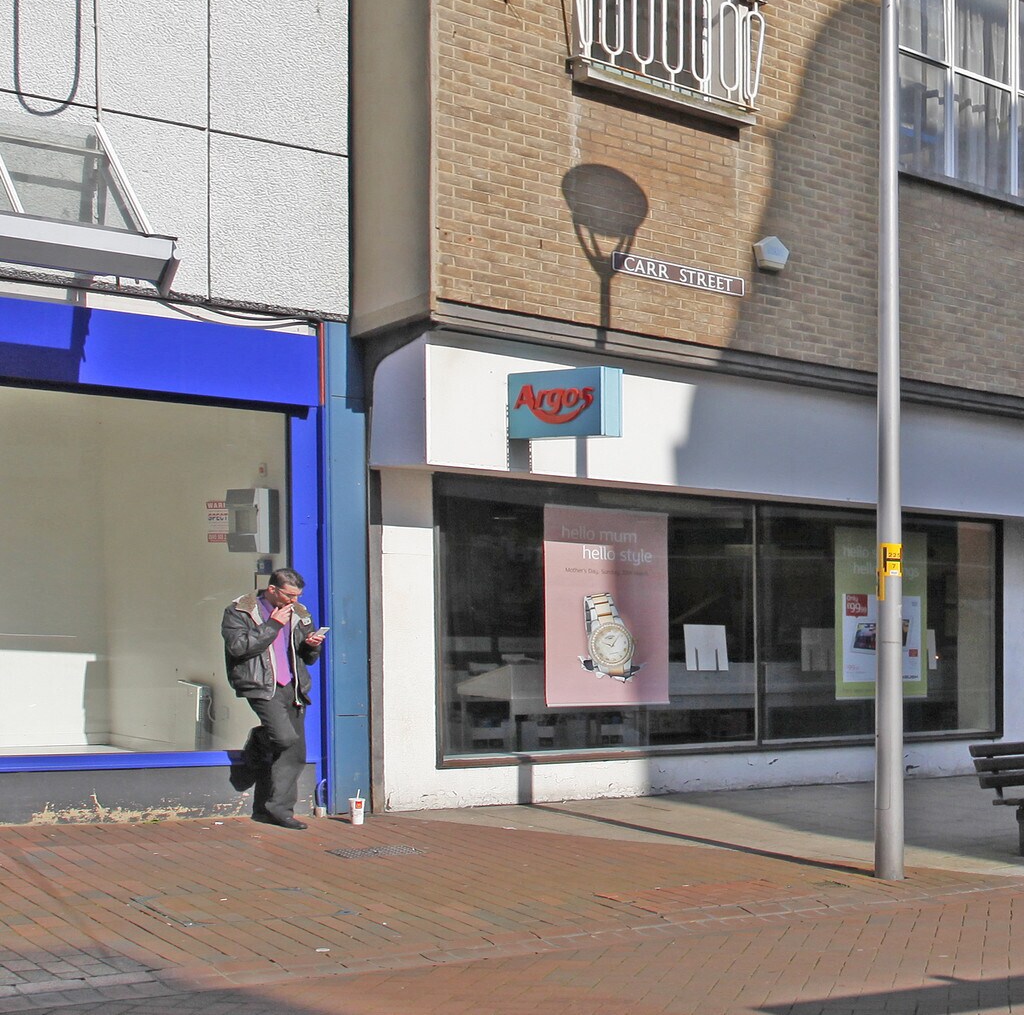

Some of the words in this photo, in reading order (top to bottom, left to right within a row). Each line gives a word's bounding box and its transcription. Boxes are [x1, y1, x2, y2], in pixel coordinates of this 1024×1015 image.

[623, 256, 670, 279] CARR
[679, 268, 734, 292] STREET
[513, 383, 596, 425] Argos
[561, 525, 596, 541] hello
[600, 530, 638, 544] mum
[582, 544, 616, 560] hello
[620, 548, 653, 566] style
